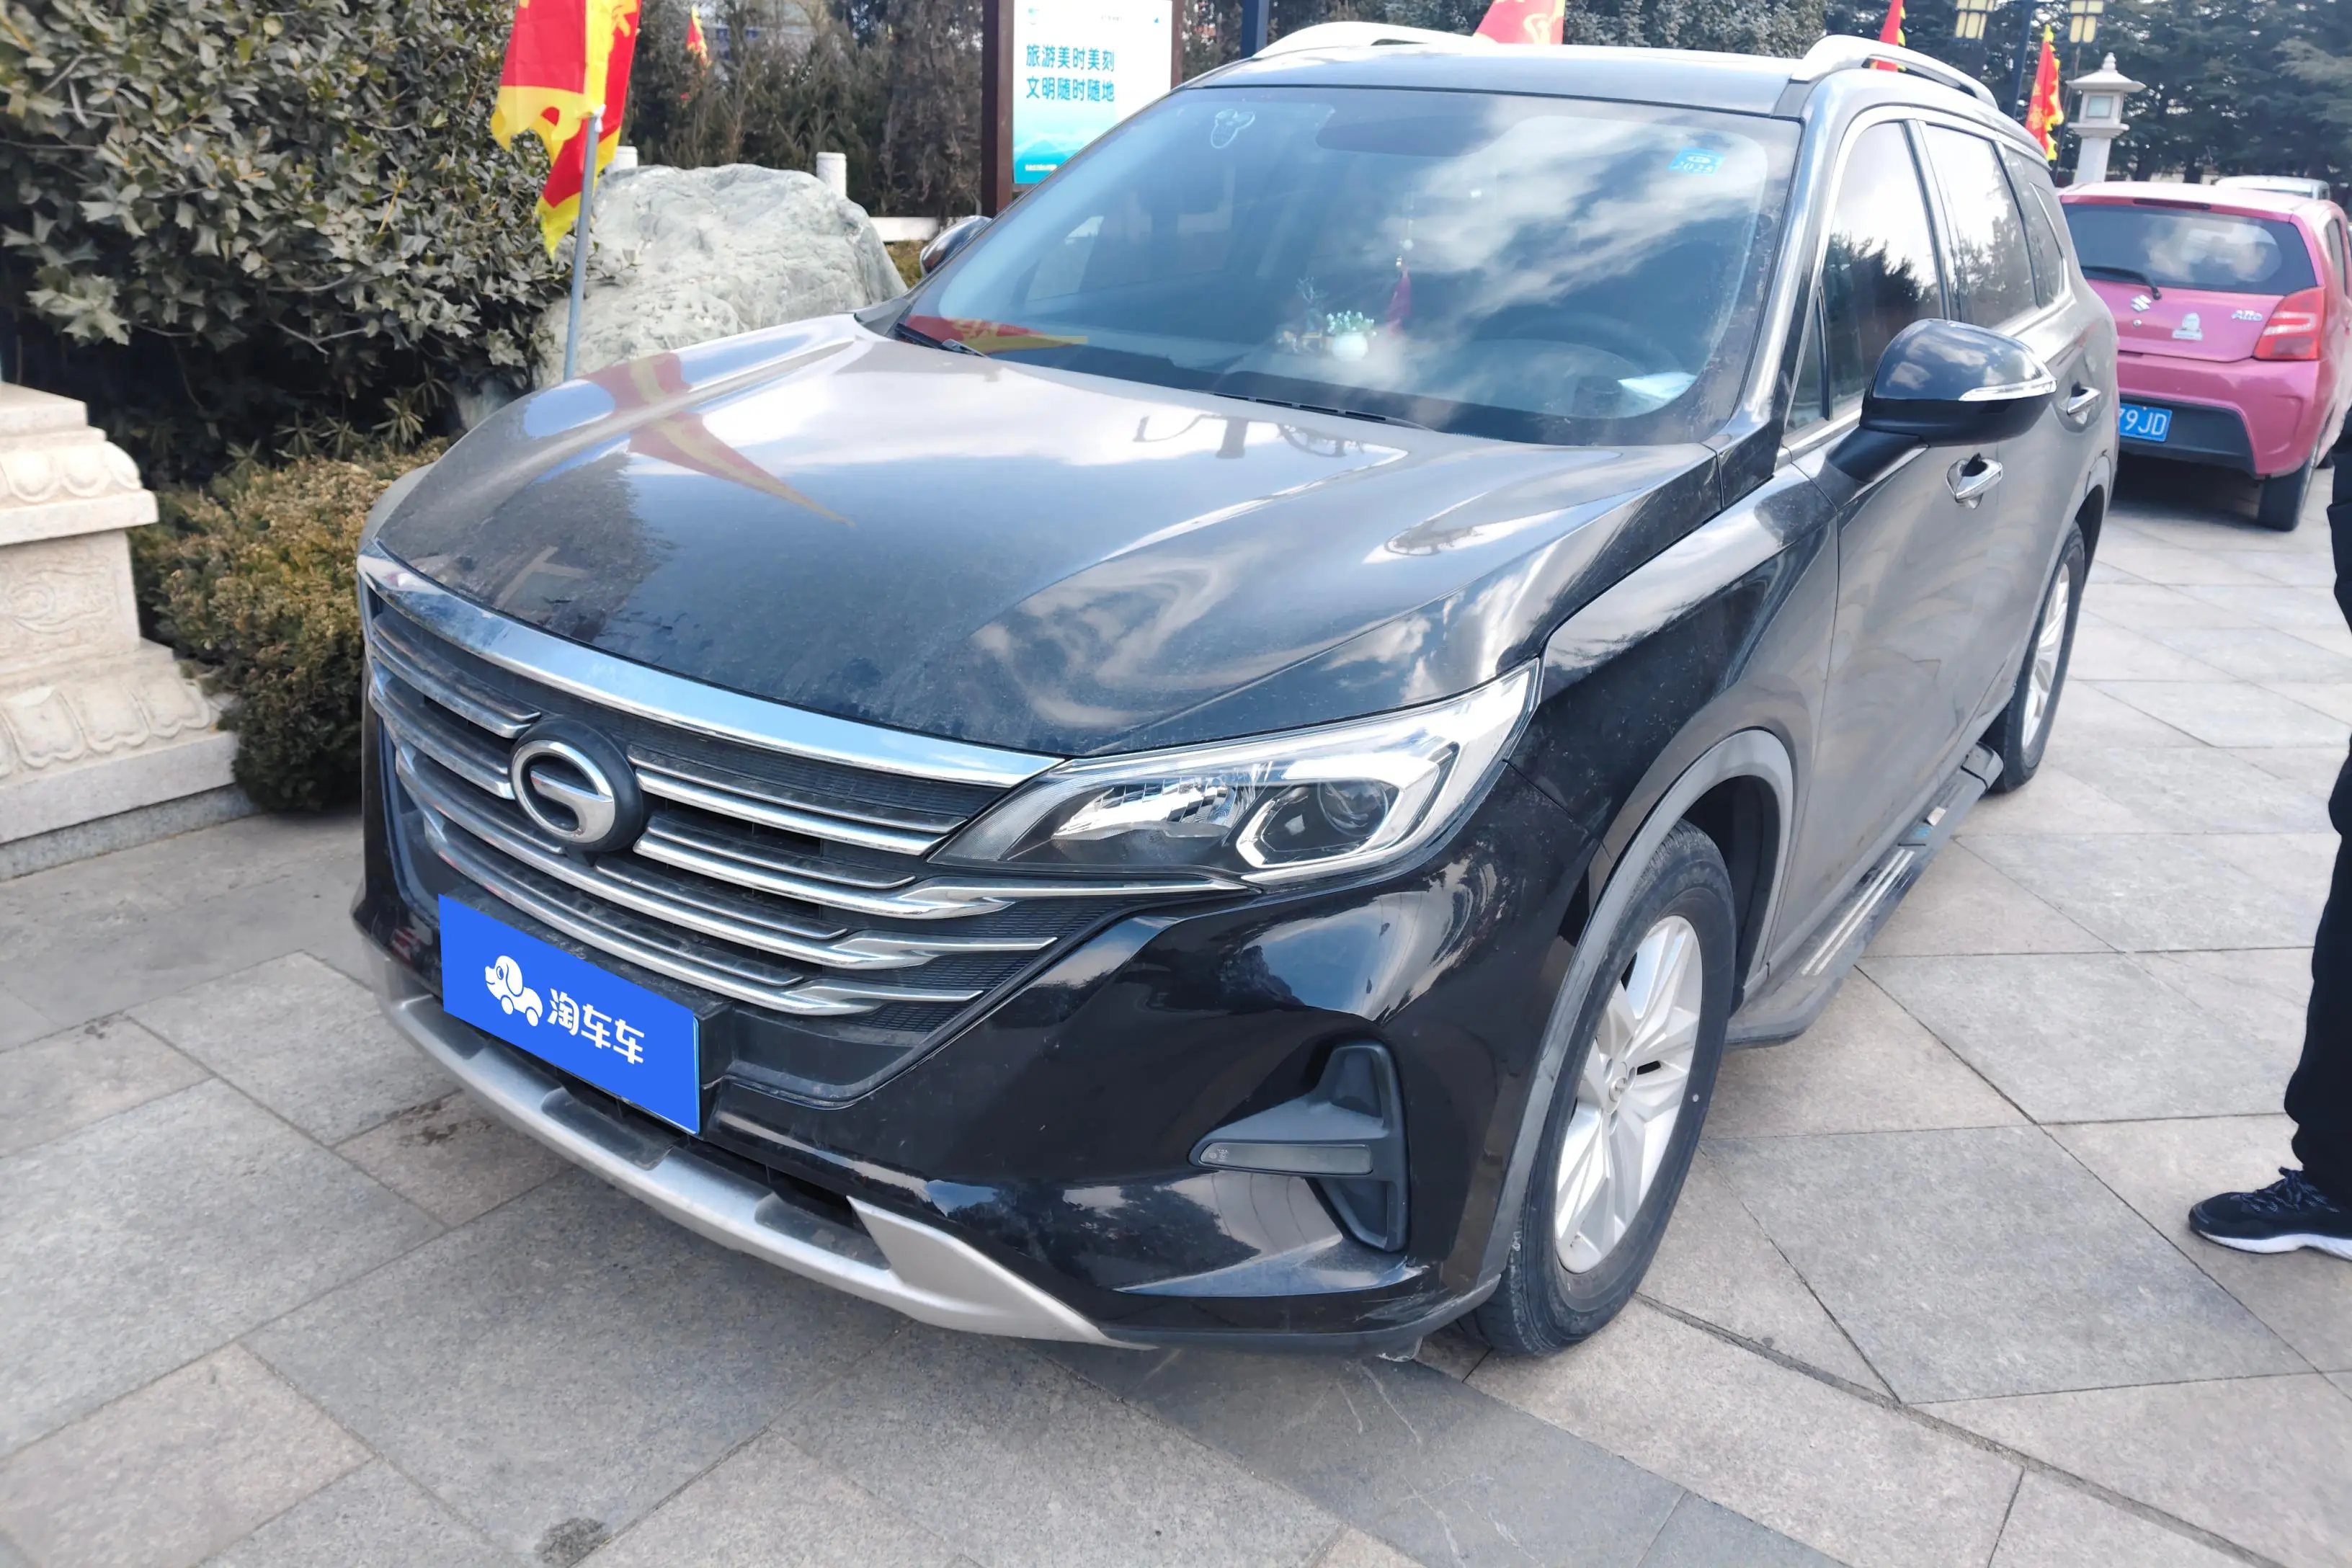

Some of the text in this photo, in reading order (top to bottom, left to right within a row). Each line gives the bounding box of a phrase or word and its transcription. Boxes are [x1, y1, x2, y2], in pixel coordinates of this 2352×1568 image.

[1025, 44, 1115, 72] 旅游美时美刻
[1025, 76, 1115, 102] 文明随时随地
